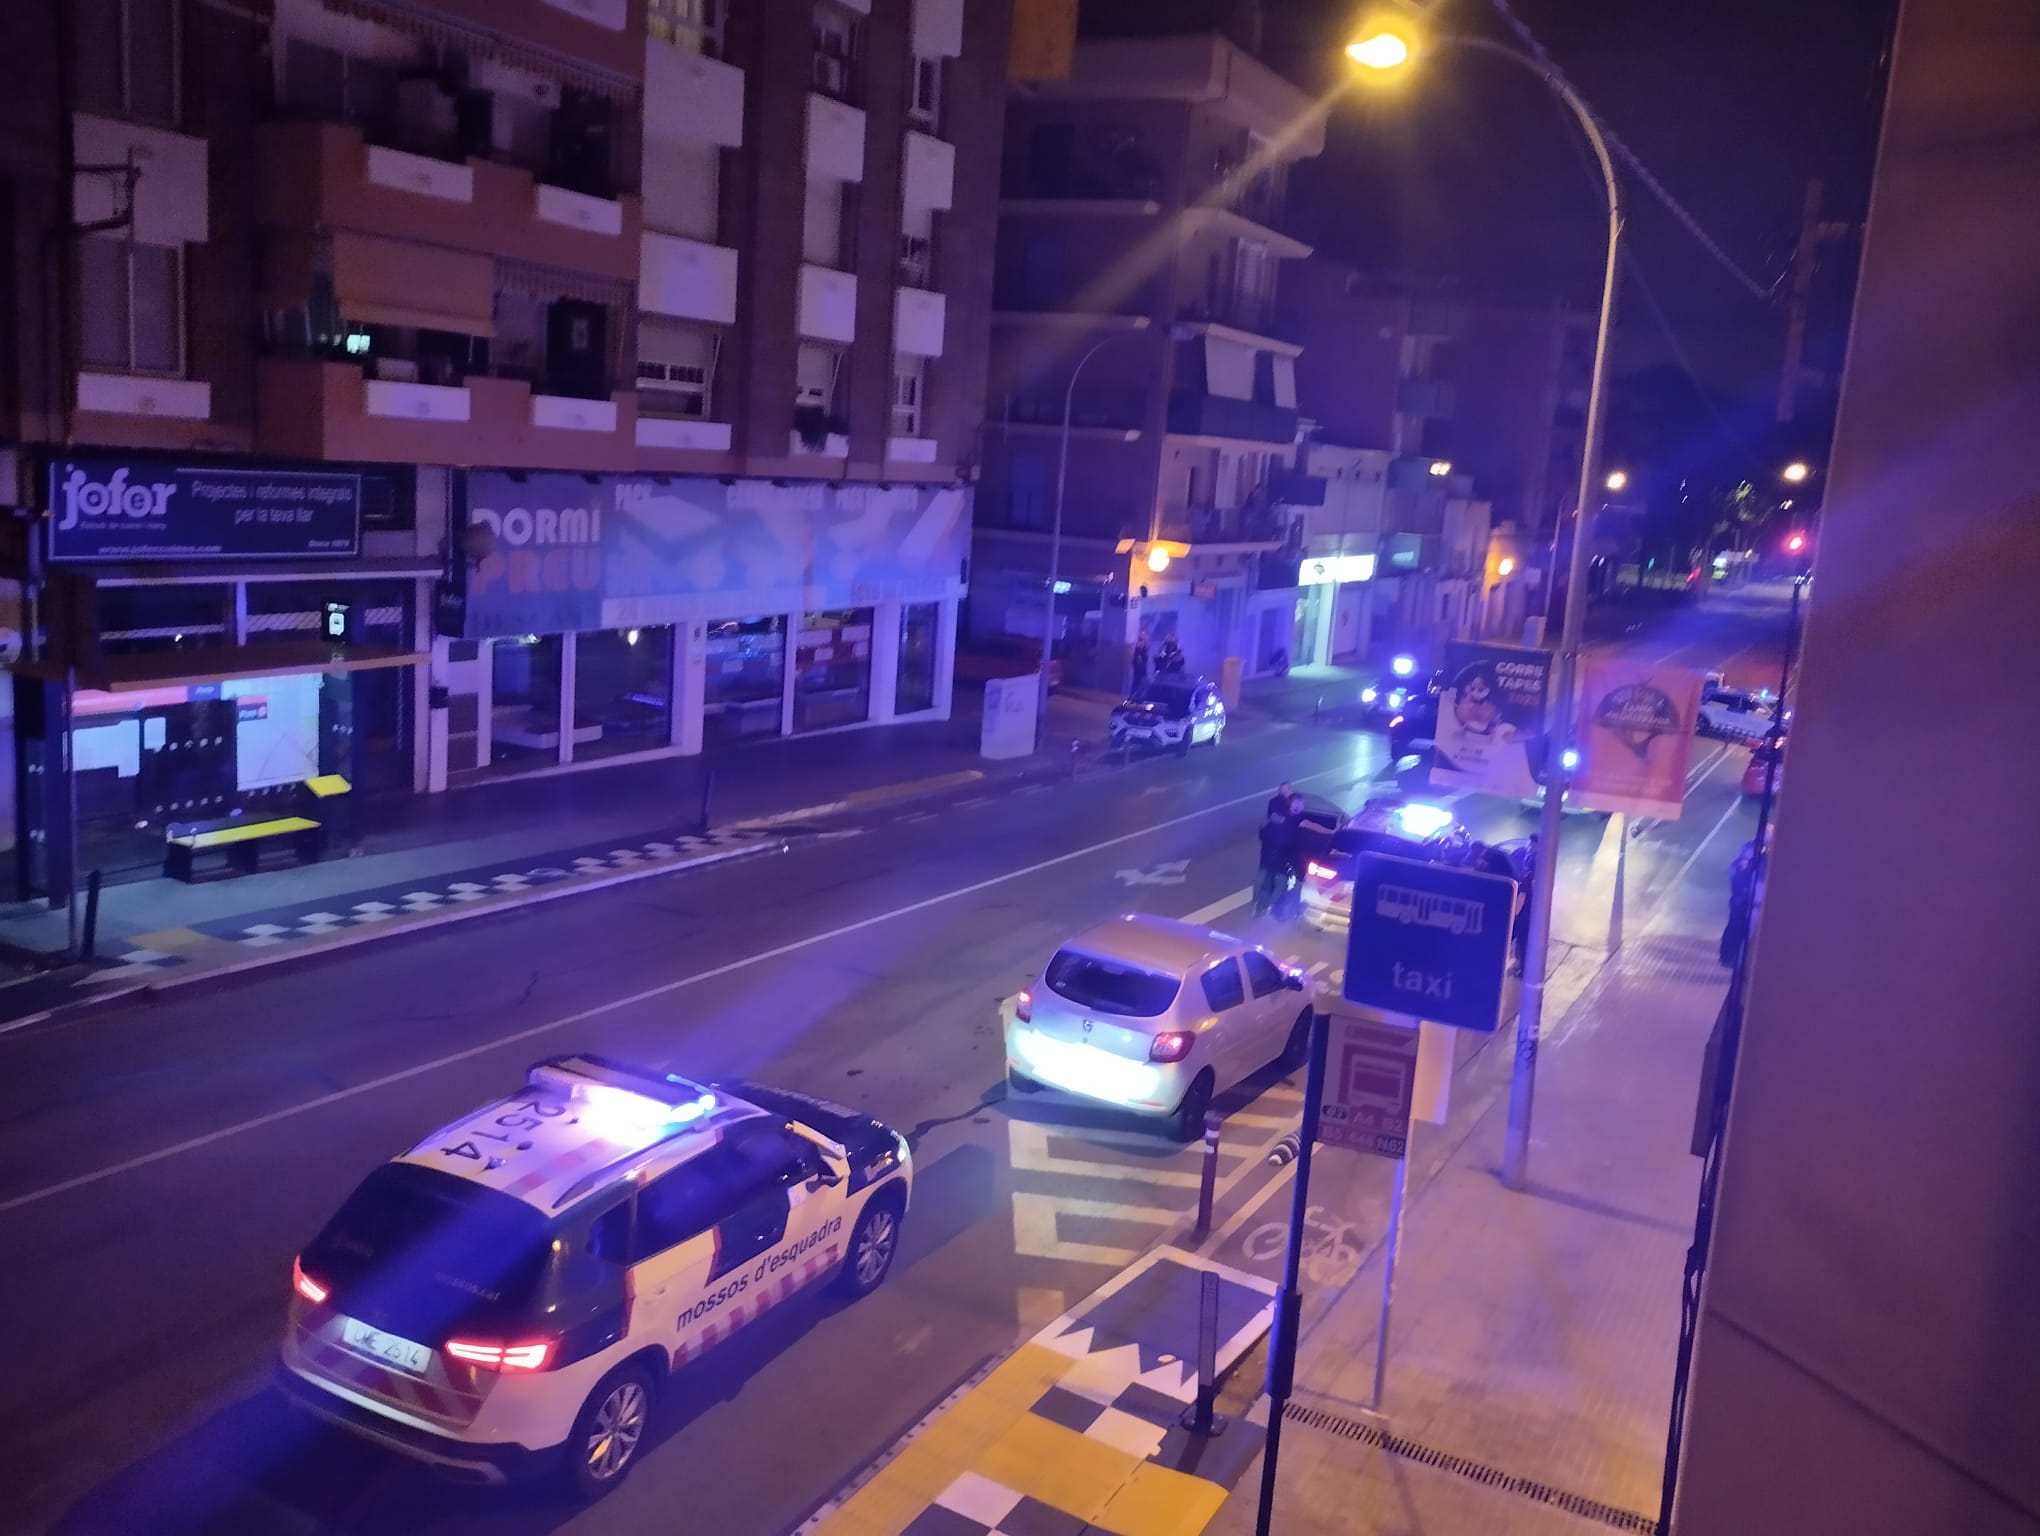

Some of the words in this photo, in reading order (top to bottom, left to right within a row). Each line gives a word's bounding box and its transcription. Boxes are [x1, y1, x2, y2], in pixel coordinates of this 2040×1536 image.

[471, 507, 601, 545] DORMI
[1391, 961, 1453, 1000] taxi
[440, 1101, 566, 1160] 2514
[676, 1274, 749, 1333] mossos
[754, 1215, 842, 1283] d'esquadra
